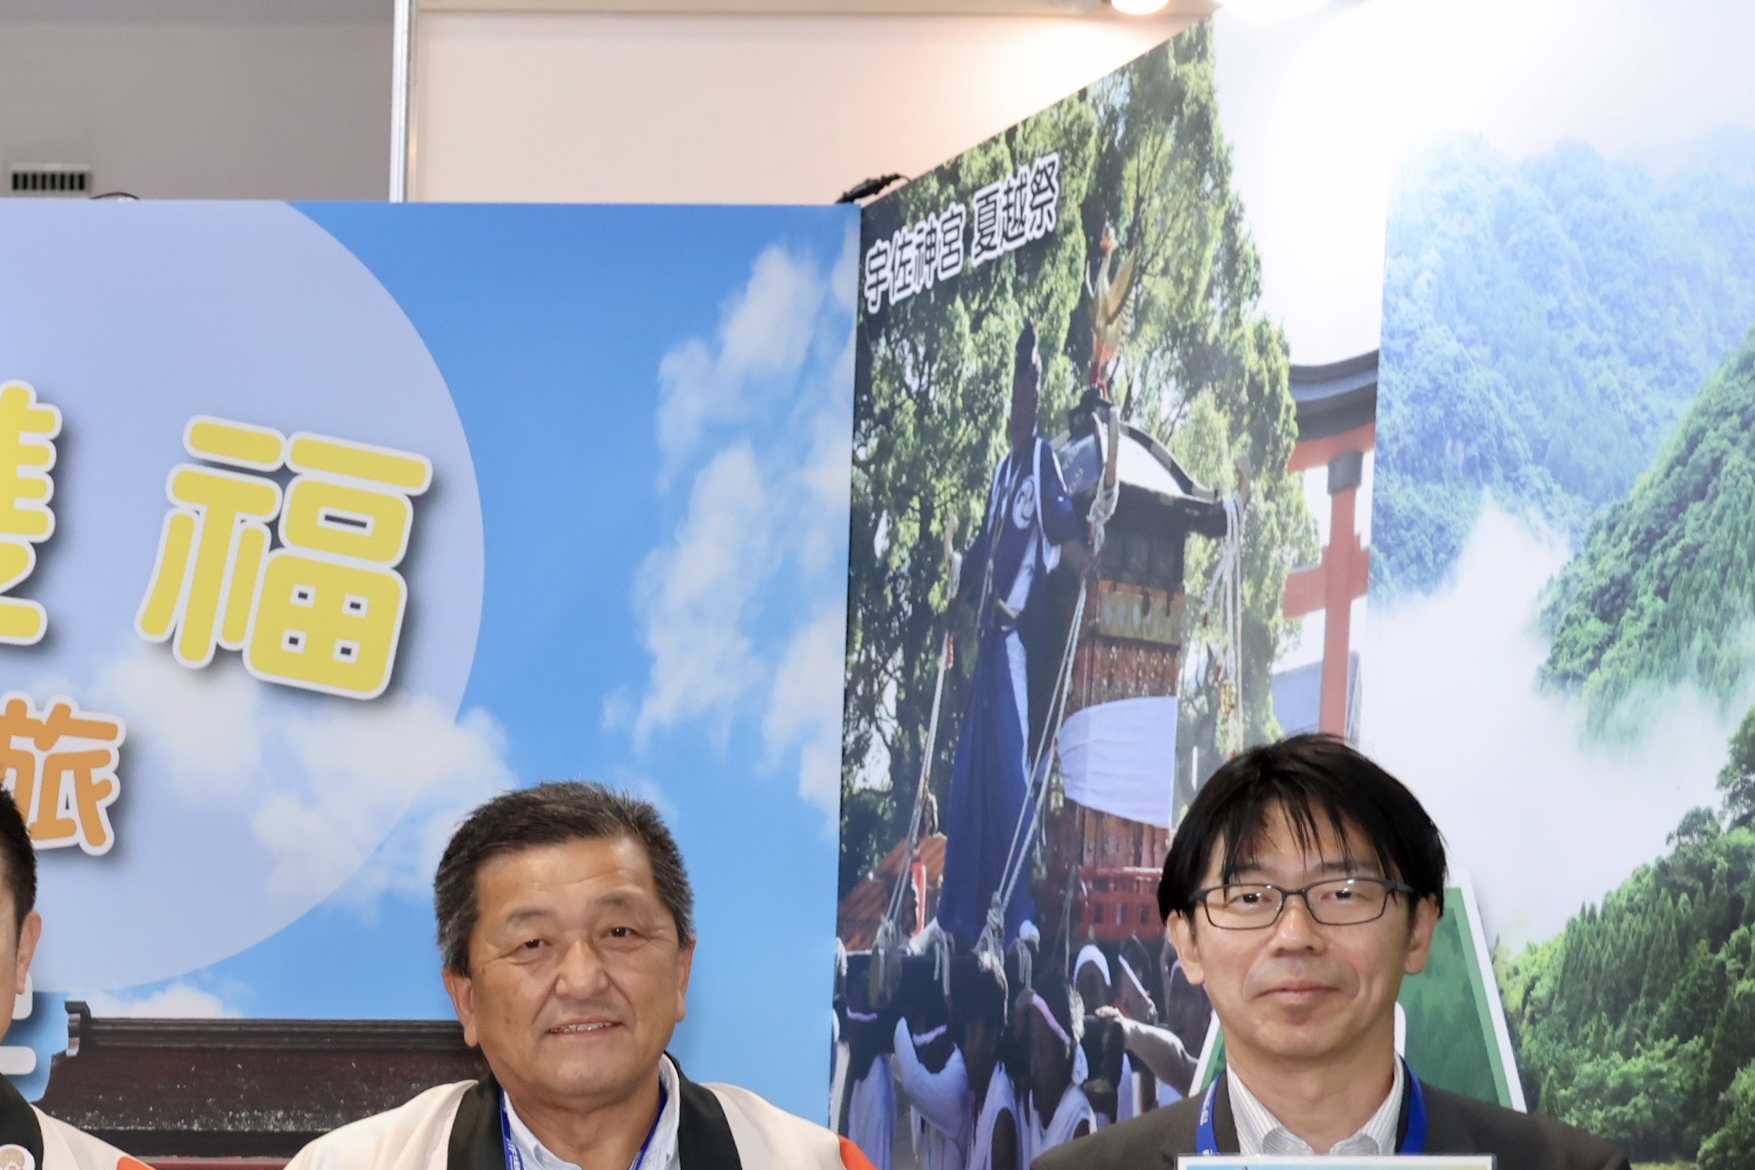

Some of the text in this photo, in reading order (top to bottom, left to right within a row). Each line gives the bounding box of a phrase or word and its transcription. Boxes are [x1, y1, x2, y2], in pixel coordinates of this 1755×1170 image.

[864, 151, 1060, 314] 宇佐神宮 夏越祭
